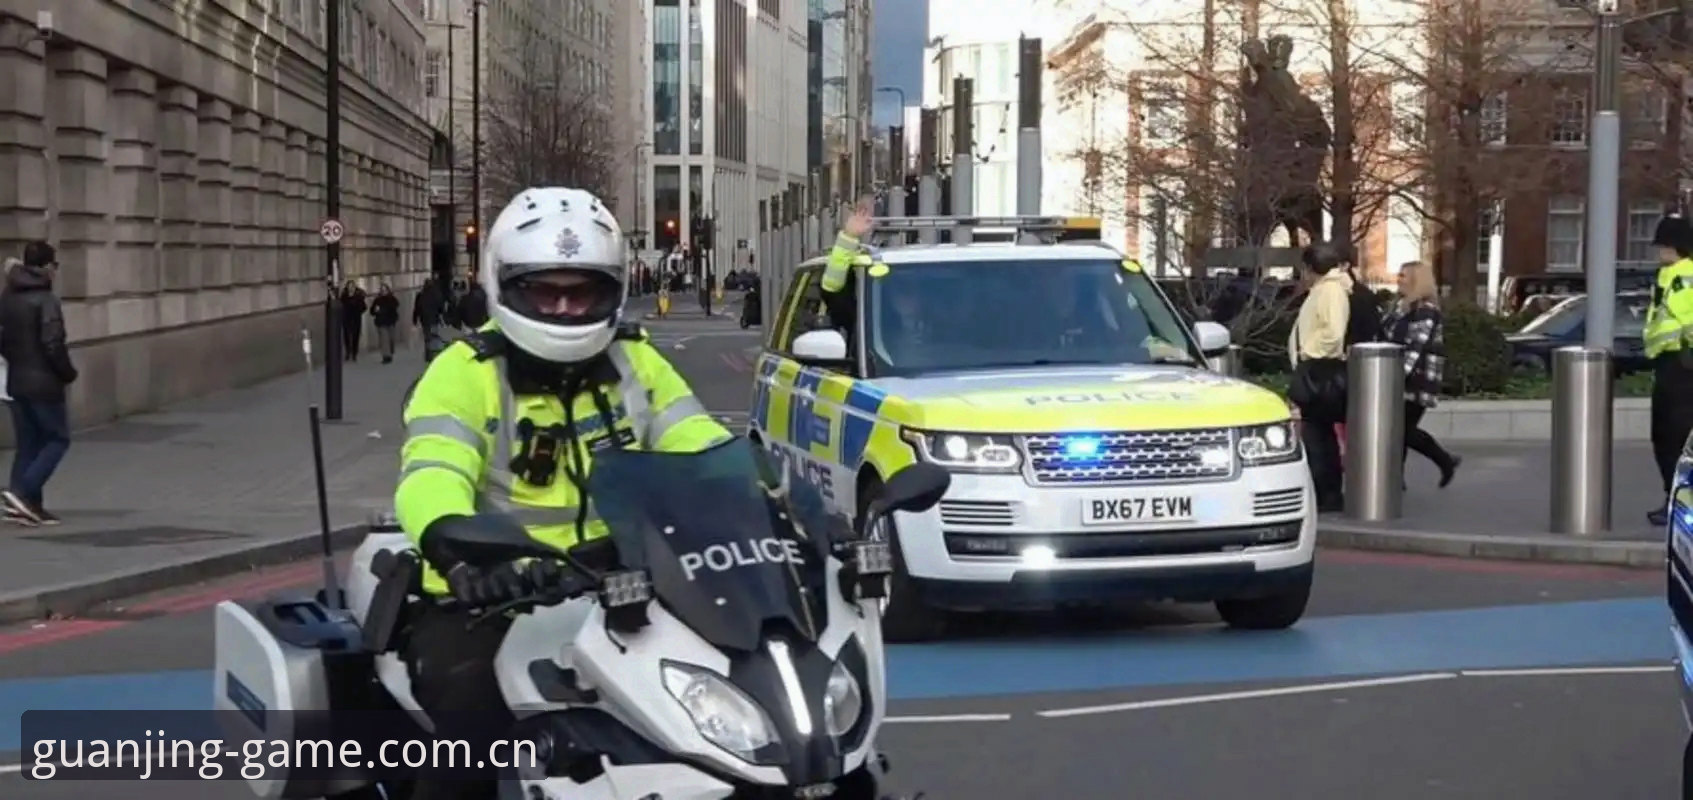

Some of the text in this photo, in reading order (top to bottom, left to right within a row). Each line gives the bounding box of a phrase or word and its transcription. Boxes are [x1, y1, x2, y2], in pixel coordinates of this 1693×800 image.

[323, 225, 342, 237] 20
[1025, 392, 1202, 406] POLICE
[1092, 496, 1192, 520] BX67 EVM
[679, 538, 805, 581] POLICE
